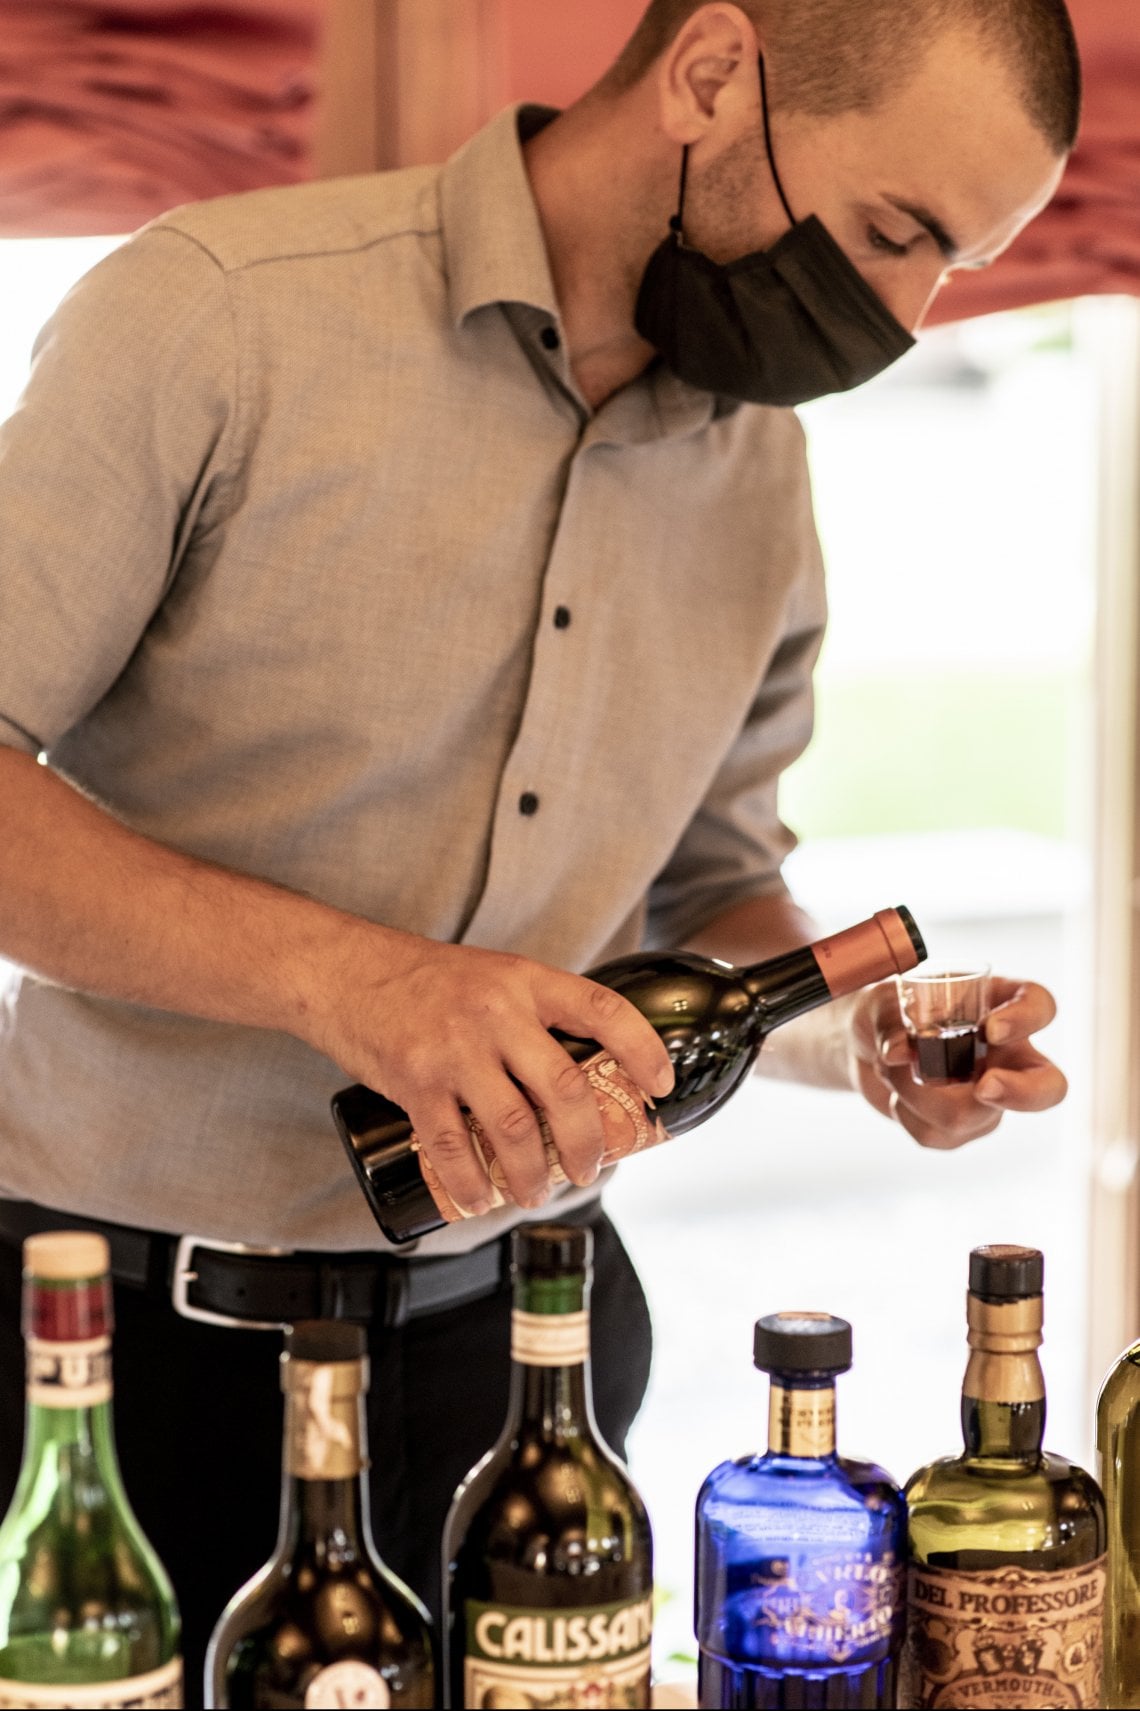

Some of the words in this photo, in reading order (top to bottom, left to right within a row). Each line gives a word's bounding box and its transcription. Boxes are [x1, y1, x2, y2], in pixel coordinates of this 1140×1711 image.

[917, 1581, 952, 1608] DEL
[960, 1580, 1098, 1614] PROFESSORE
[958, 1678, 1054, 1697] VERMOUTH
